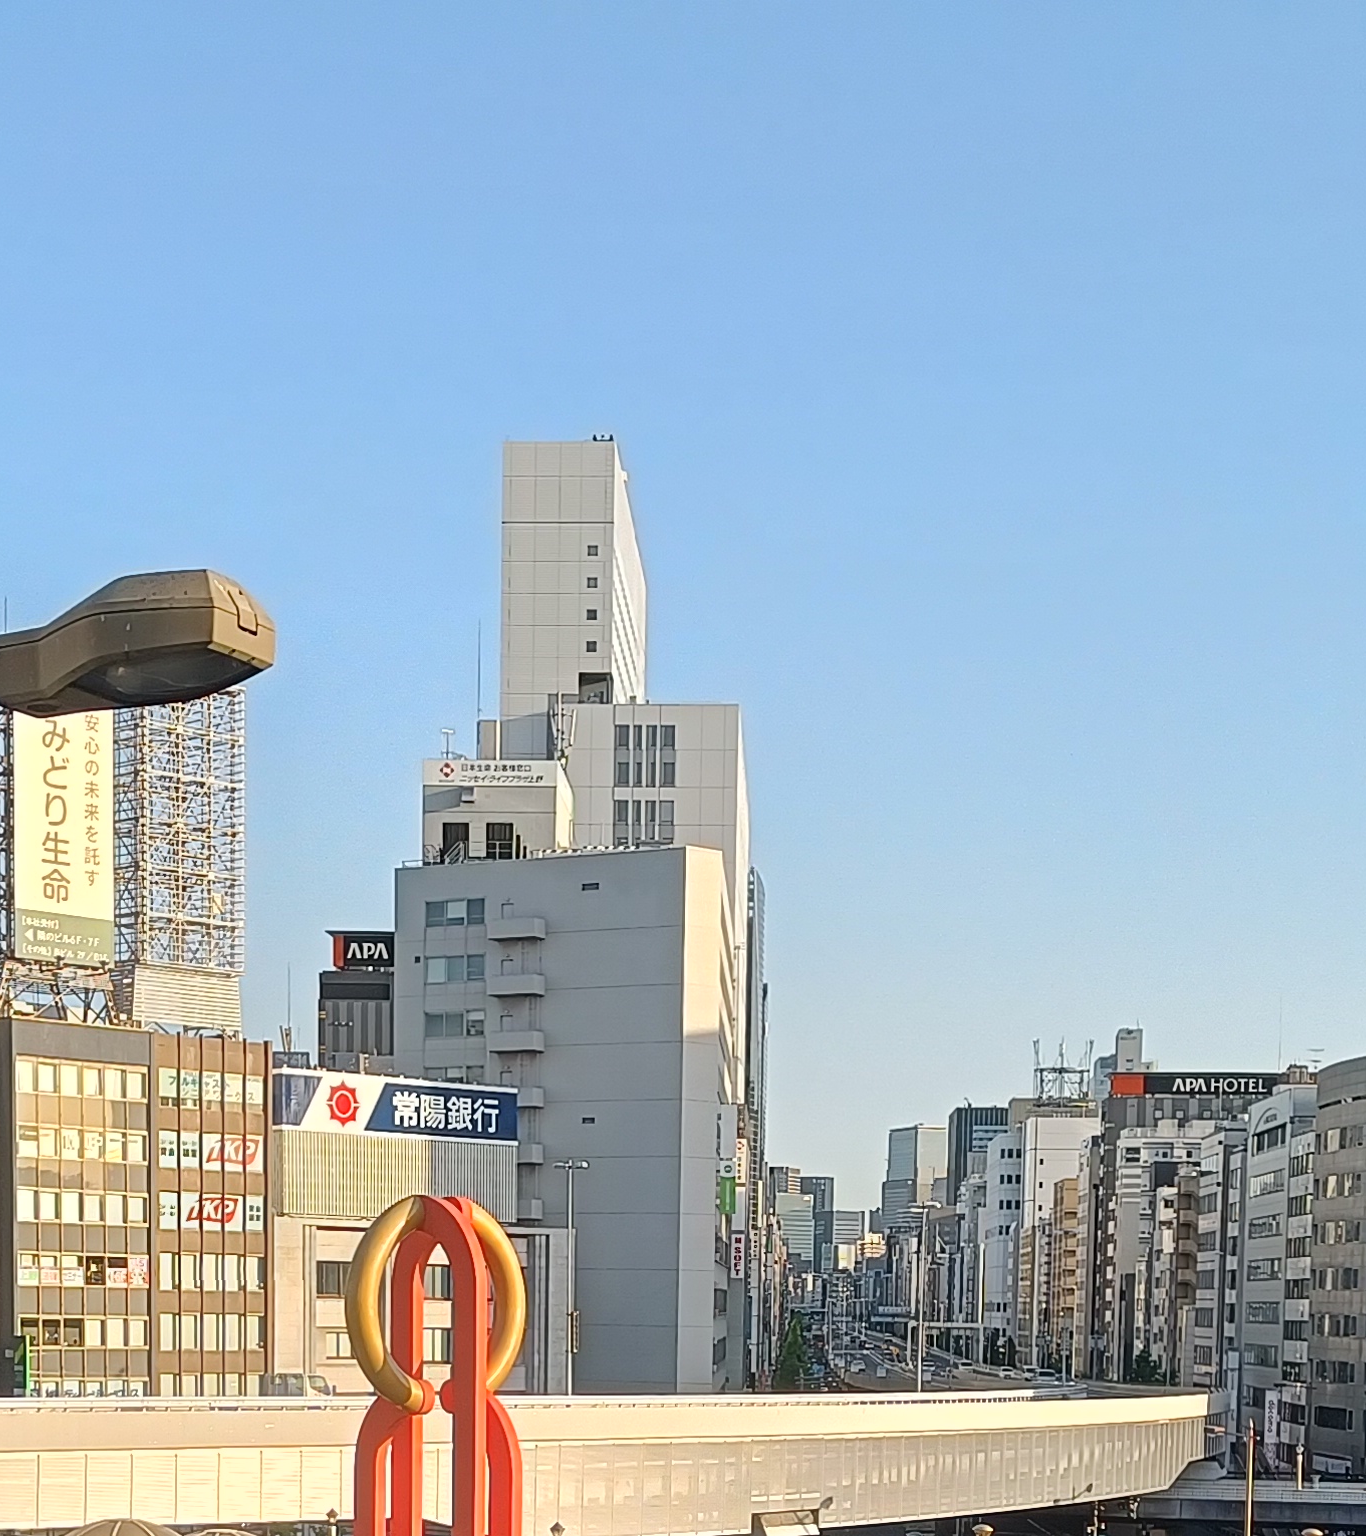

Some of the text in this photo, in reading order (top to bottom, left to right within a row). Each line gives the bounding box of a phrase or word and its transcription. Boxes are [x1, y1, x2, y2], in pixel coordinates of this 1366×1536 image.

[41, 719, 71, 903] みどり生命
[84, 714, 100, 886] 安心の未来を託す
[347, 942, 389, 959] APA
[1172, 1078, 1267, 1093] APA HOTEL
[392, 1091, 500, 1134] 常陽銀行
